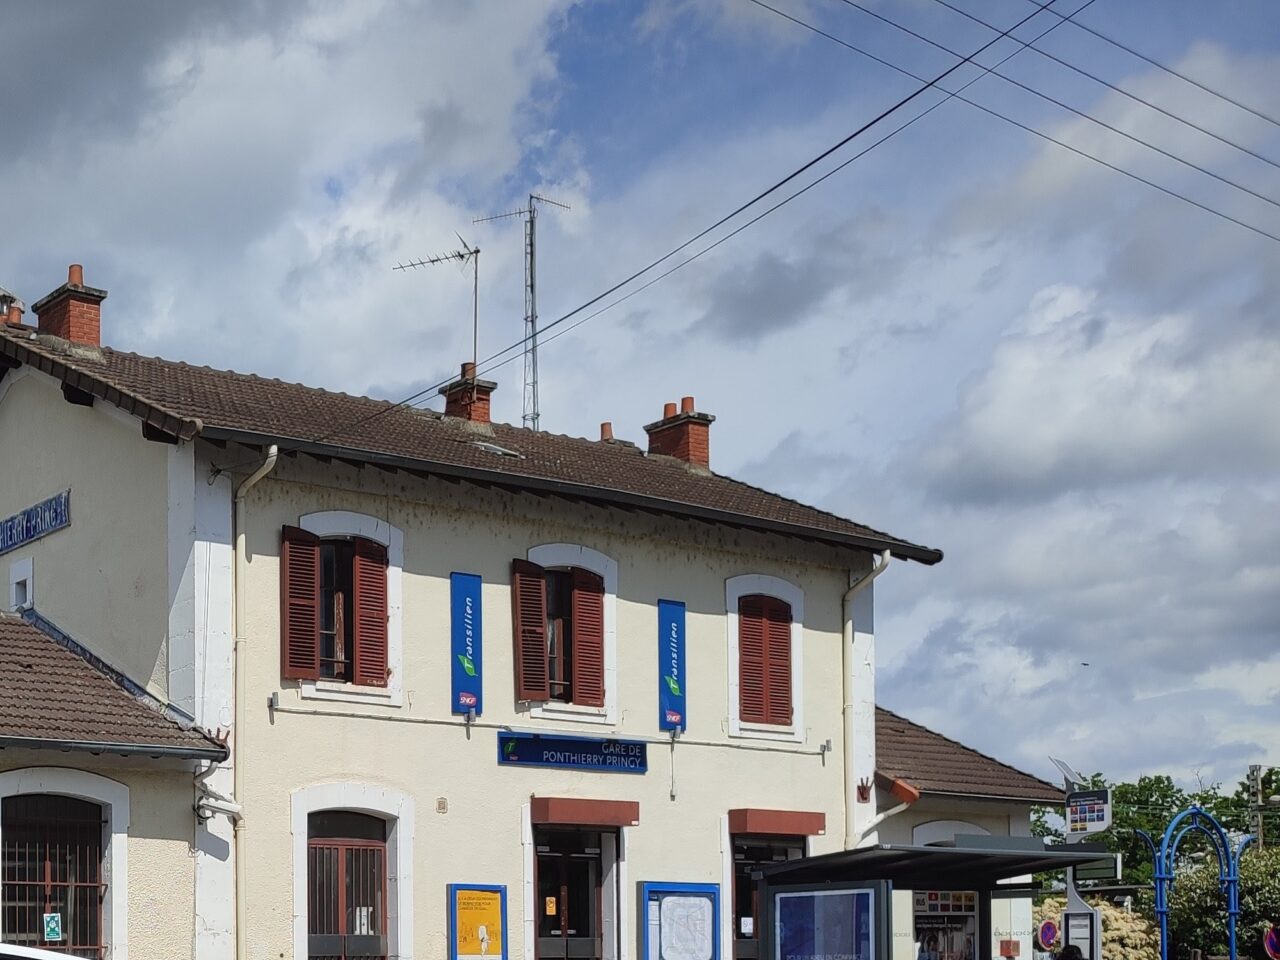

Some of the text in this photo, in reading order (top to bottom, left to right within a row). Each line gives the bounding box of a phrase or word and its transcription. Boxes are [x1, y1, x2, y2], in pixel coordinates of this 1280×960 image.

[464, 597, 473, 669] Transilien
[670, 622, 678, 689] Transilien
[543, 751, 641, 768] PONTHIERRY PRINGY
[602, 743, 641, 756] GARE DE
